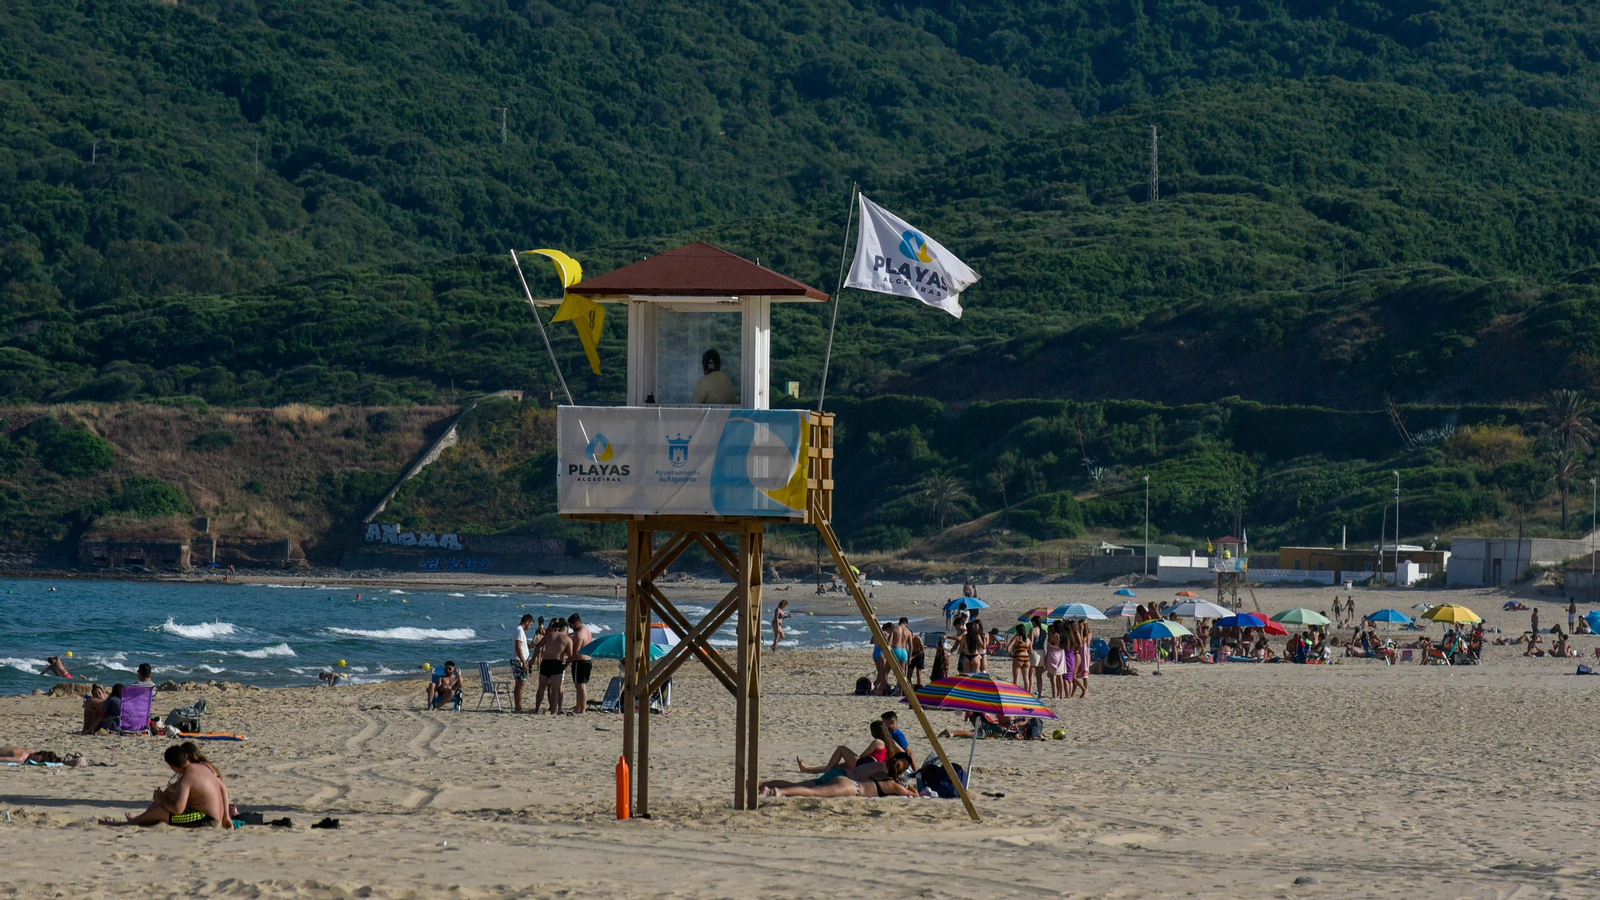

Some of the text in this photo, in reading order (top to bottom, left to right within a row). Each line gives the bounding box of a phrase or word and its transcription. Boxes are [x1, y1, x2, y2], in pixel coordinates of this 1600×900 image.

[873, 255, 948, 292] PLAYAS
[883, 277, 942, 297] ALGEIRAS
[568, 464, 631, 476] PLAYAS
[655, 469, 701, 477] Ayuntamiento
